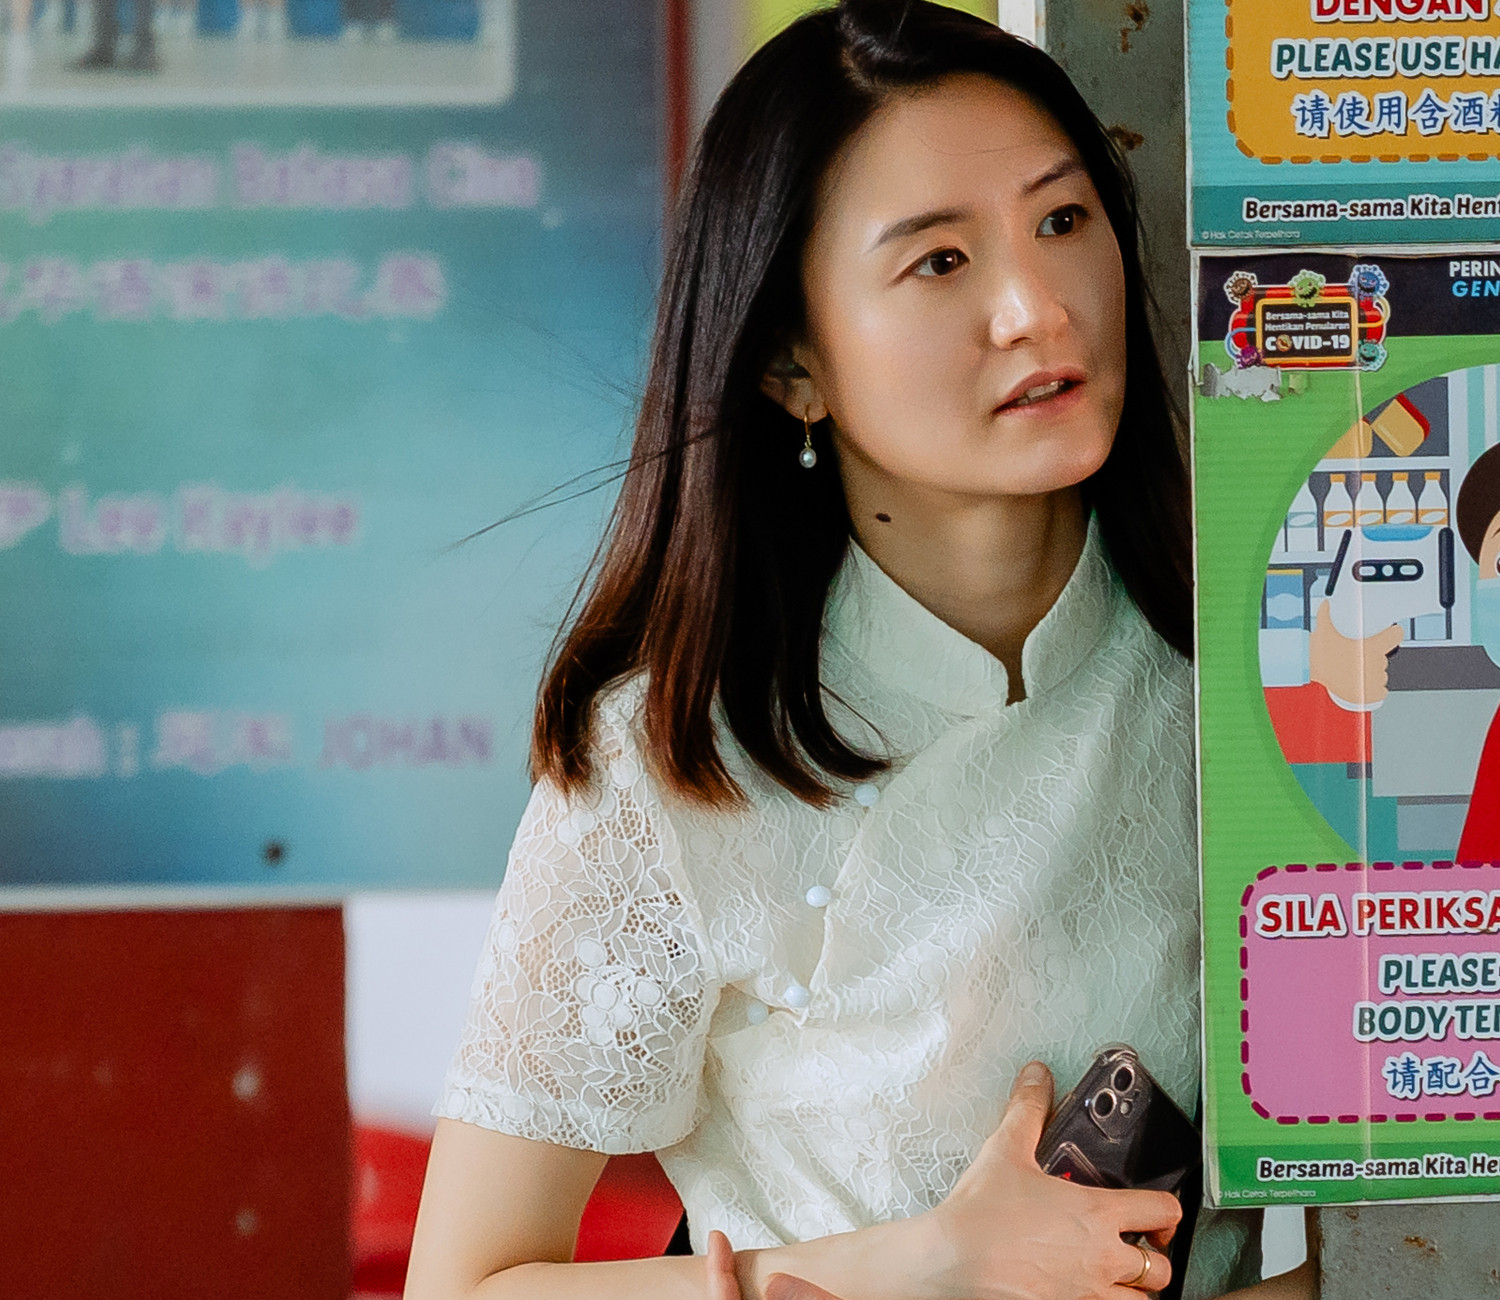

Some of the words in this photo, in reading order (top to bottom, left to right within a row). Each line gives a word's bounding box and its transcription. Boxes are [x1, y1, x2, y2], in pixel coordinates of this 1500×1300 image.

[1276, 42, 1391, 73] PLEASE
[1401, 41, 1461, 71] USE
[1246, 199, 1405, 219] Bersama-sama
[1410, 196, 1451, 214] Kita
[1261, 900, 1342, 932] SILA
[1384, 958, 1497, 988] PLEASE
[1359, 1005, 1448, 1035] BODY
[1260, 1158, 1420, 1179] Bersama-sama
[1426, 1156, 1467, 1176] Kita
